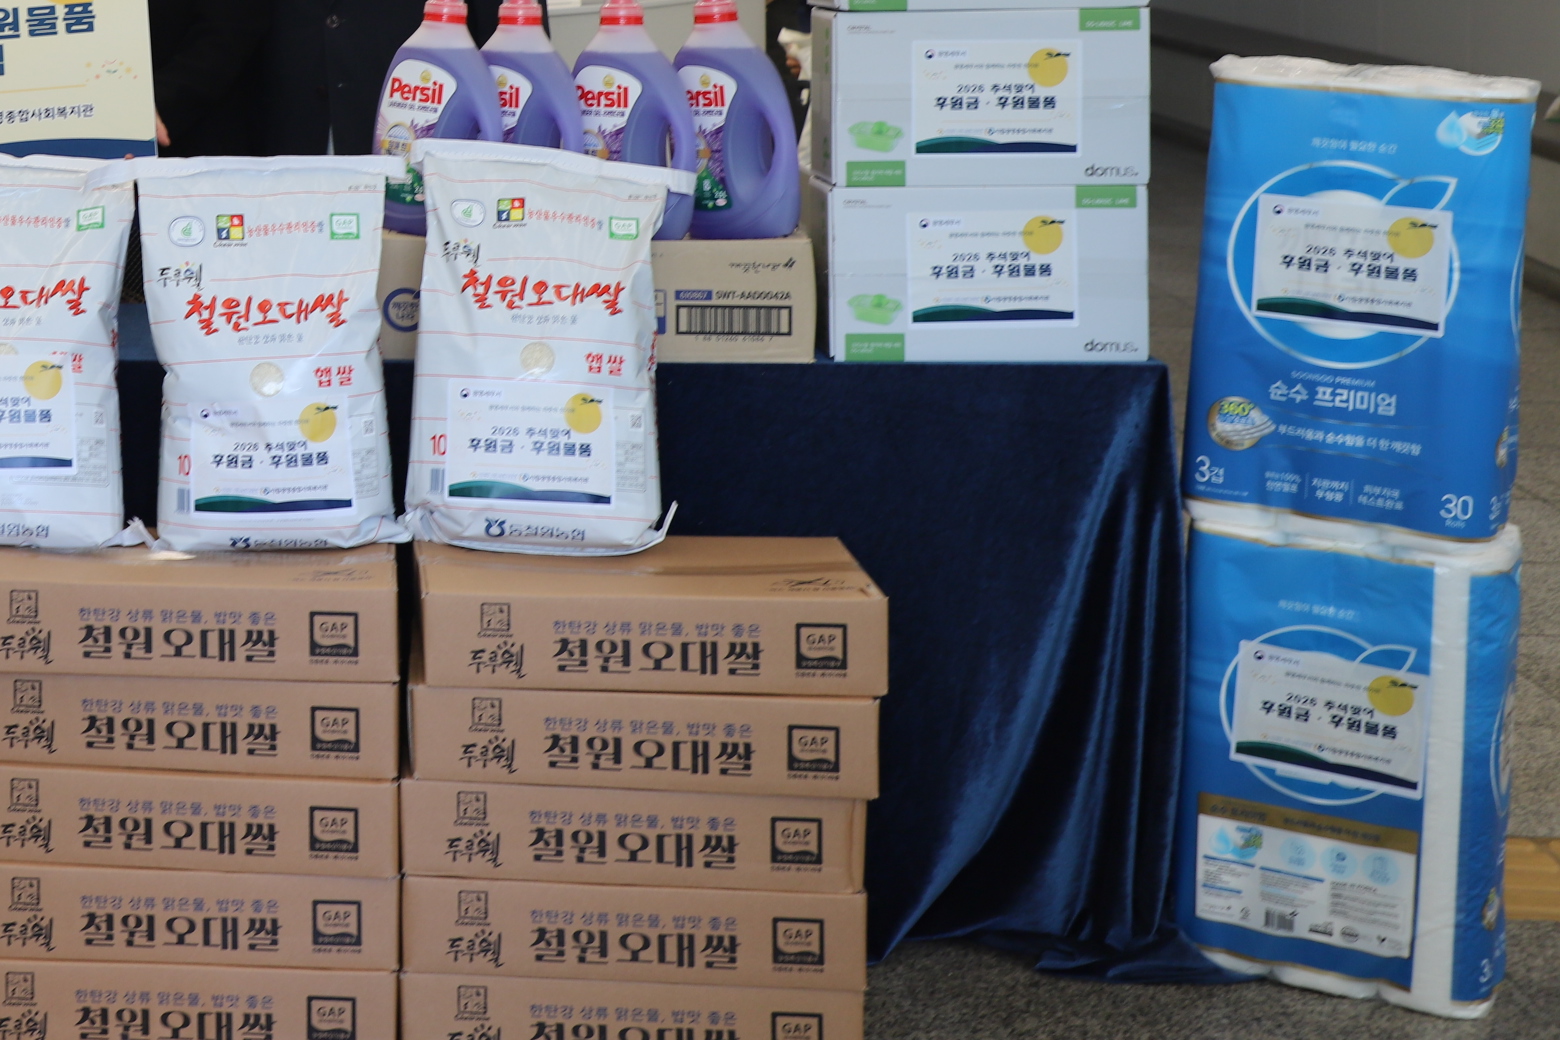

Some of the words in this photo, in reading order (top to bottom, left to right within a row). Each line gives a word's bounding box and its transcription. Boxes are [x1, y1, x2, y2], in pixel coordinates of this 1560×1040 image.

[389, 76, 444, 105] Persil
[686, 83, 726, 108] ersil
[184, 289, 350, 337] 철원오대쌀
[460, 269, 626, 317] 철원오대쌀
[1269, 380, 1309, 402] 순수
[1314, 386, 1397, 416] 프리미엄
[1439, 493, 1474, 520] 30
[78, 606, 120, 622] 한탄강
[126, 608, 154, 623] 상류
[214, 610, 242, 625] 밥맛
[248, 610, 277, 626] 좋은
[319, 621, 348, 634] GAP
[78, 624, 279, 664] 철원오대쌀
[552, 637, 764, 677] 철원오대쌀
[806, 633, 836, 646] GAP
[80, 715, 280, 757] 철원오대쌀
[543, 733, 755, 777] 철원오대쌀
[78, 814, 279, 857] 철원오대쌀
[528, 827, 740, 870] 철원오대쌀
[79, 911, 282, 953] 철원오대쌀
[529, 927, 741, 970] 철원오대쌀
